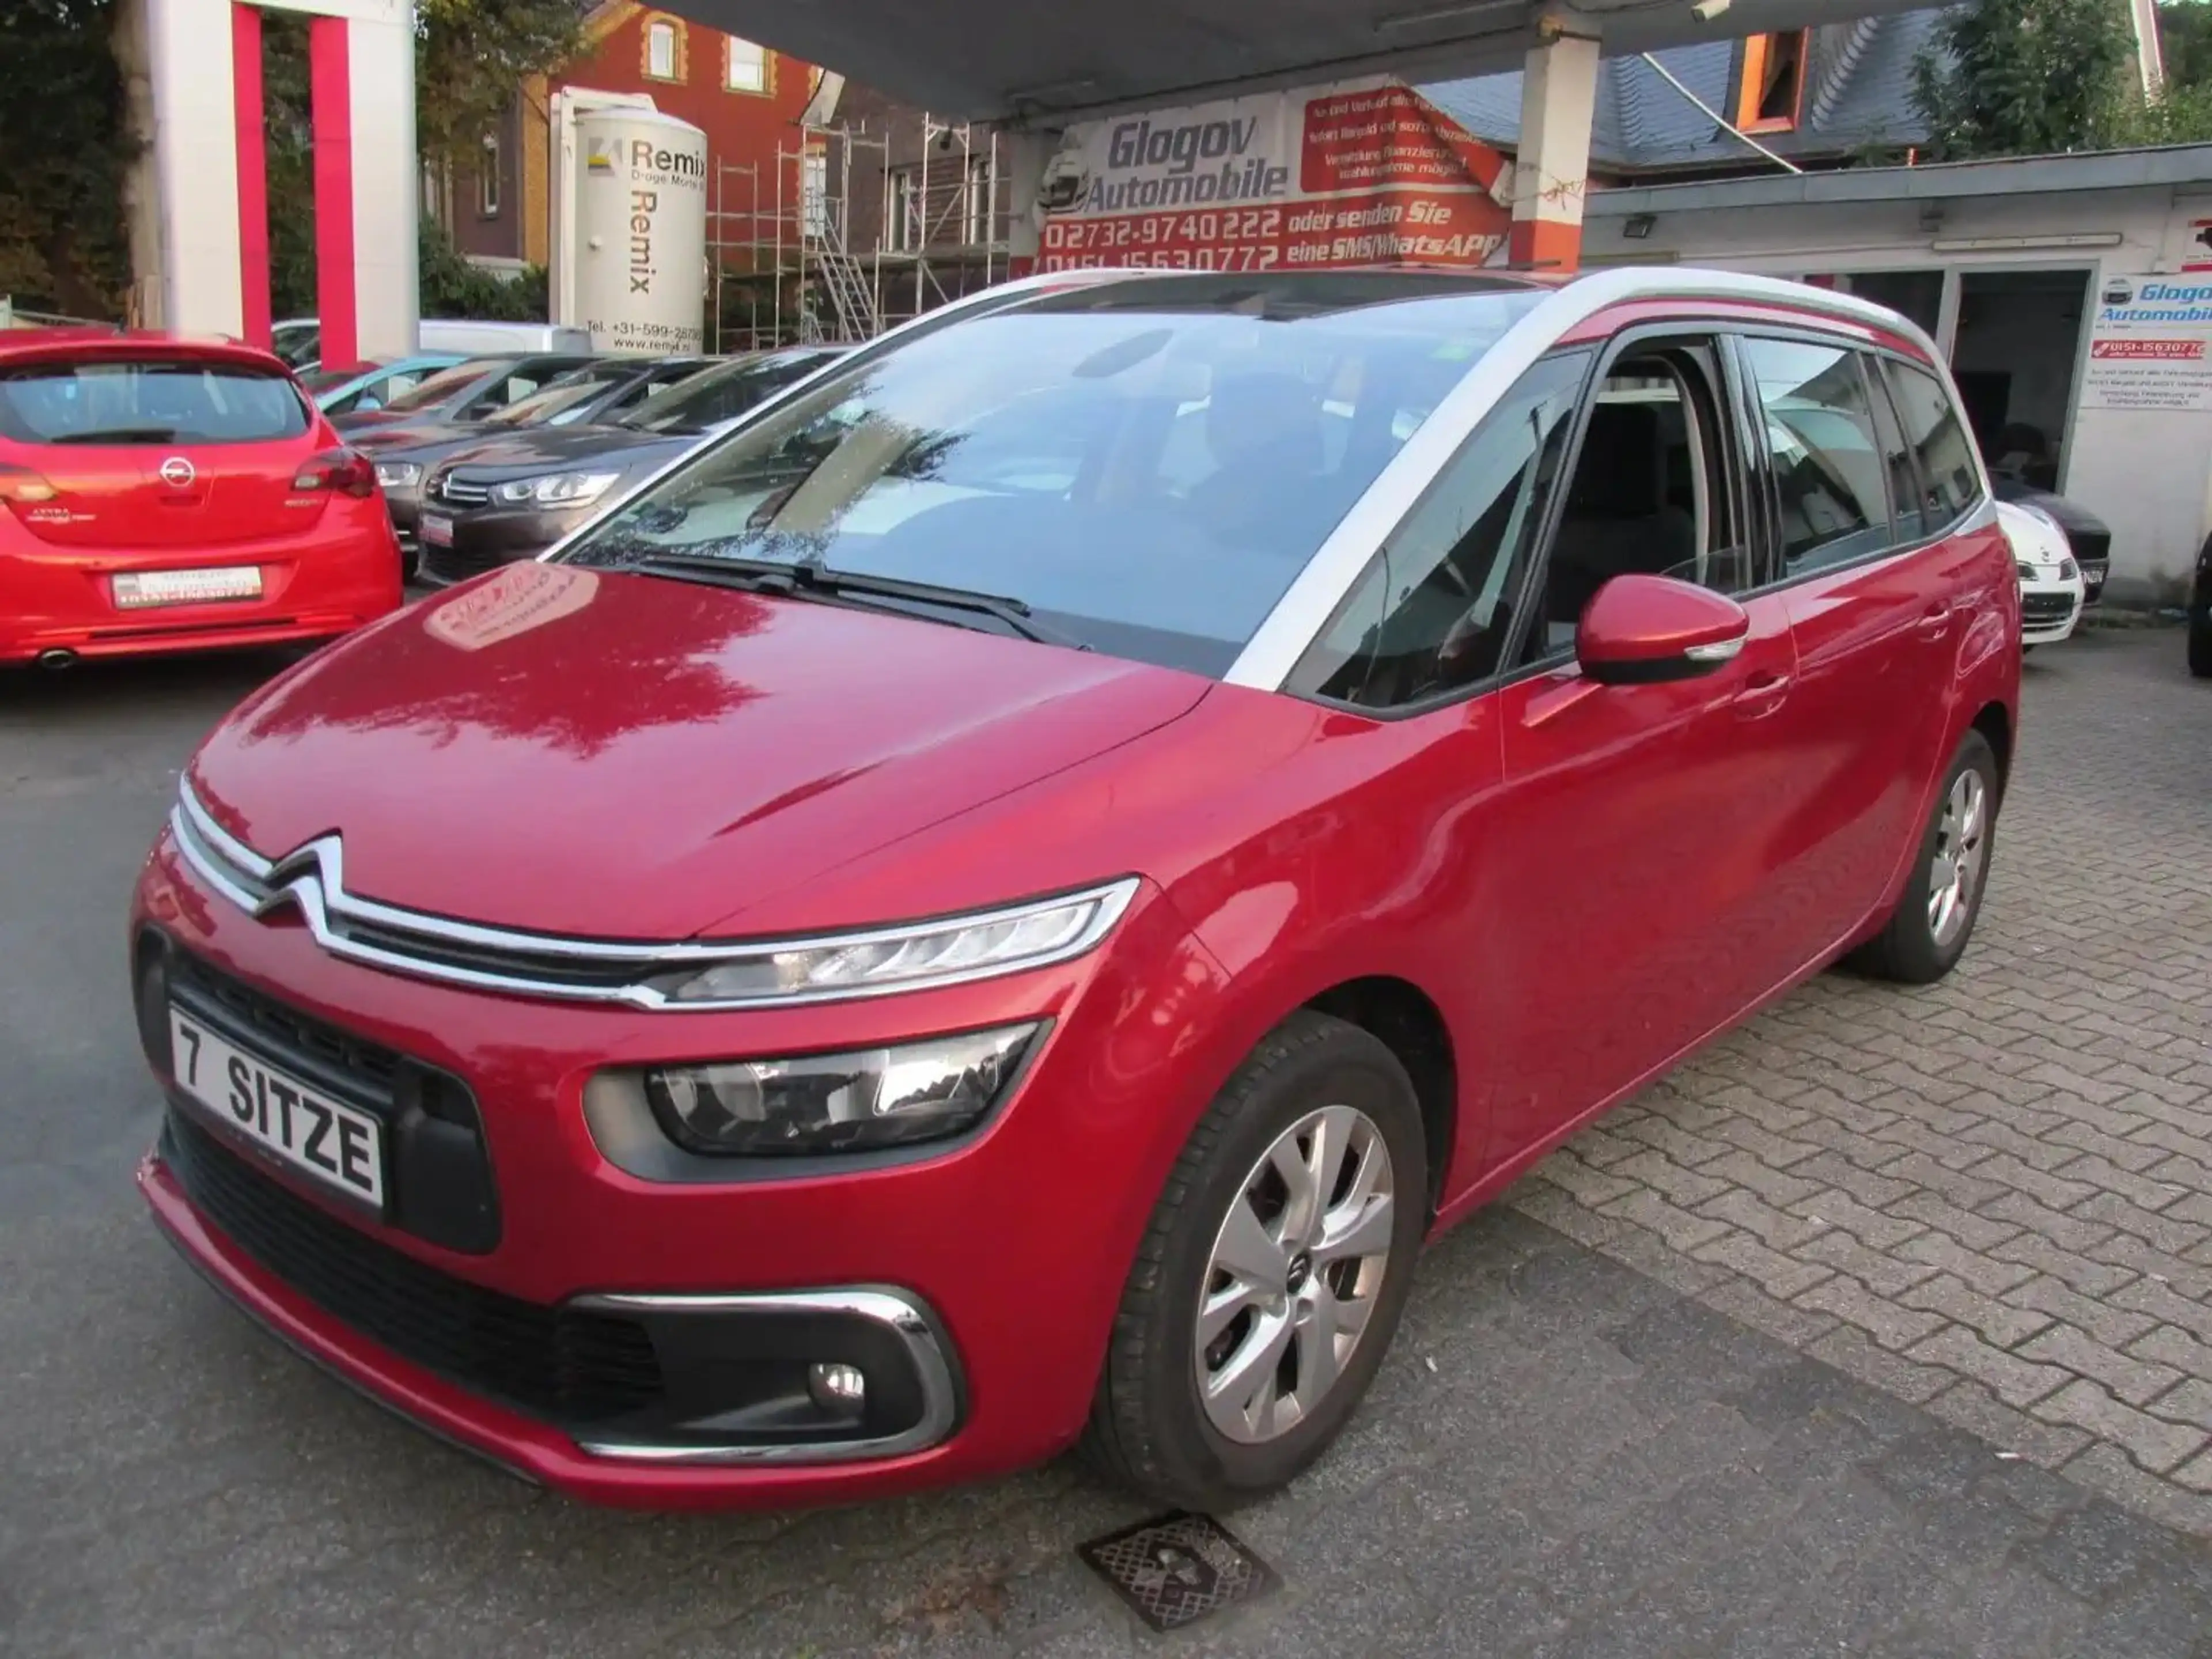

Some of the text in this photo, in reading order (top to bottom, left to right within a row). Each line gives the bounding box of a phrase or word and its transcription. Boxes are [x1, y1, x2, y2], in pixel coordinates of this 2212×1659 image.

[631, 139, 705, 177] Remix
[1108, 115, 1257, 175] Glogov
[1086, 158, 1289, 213] Automobile
[1288, 209, 1336, 233] oder
[1336, 202, 1402, 228] senden
[1406, 199, 1452, 225] Sie
[630, 190, 657, 295] Remix
[1286, 242, 1331, 262] eine
[588, 320, 607, 333] Tel.
[180, 1021, 373, 1193] 7 SITZE
